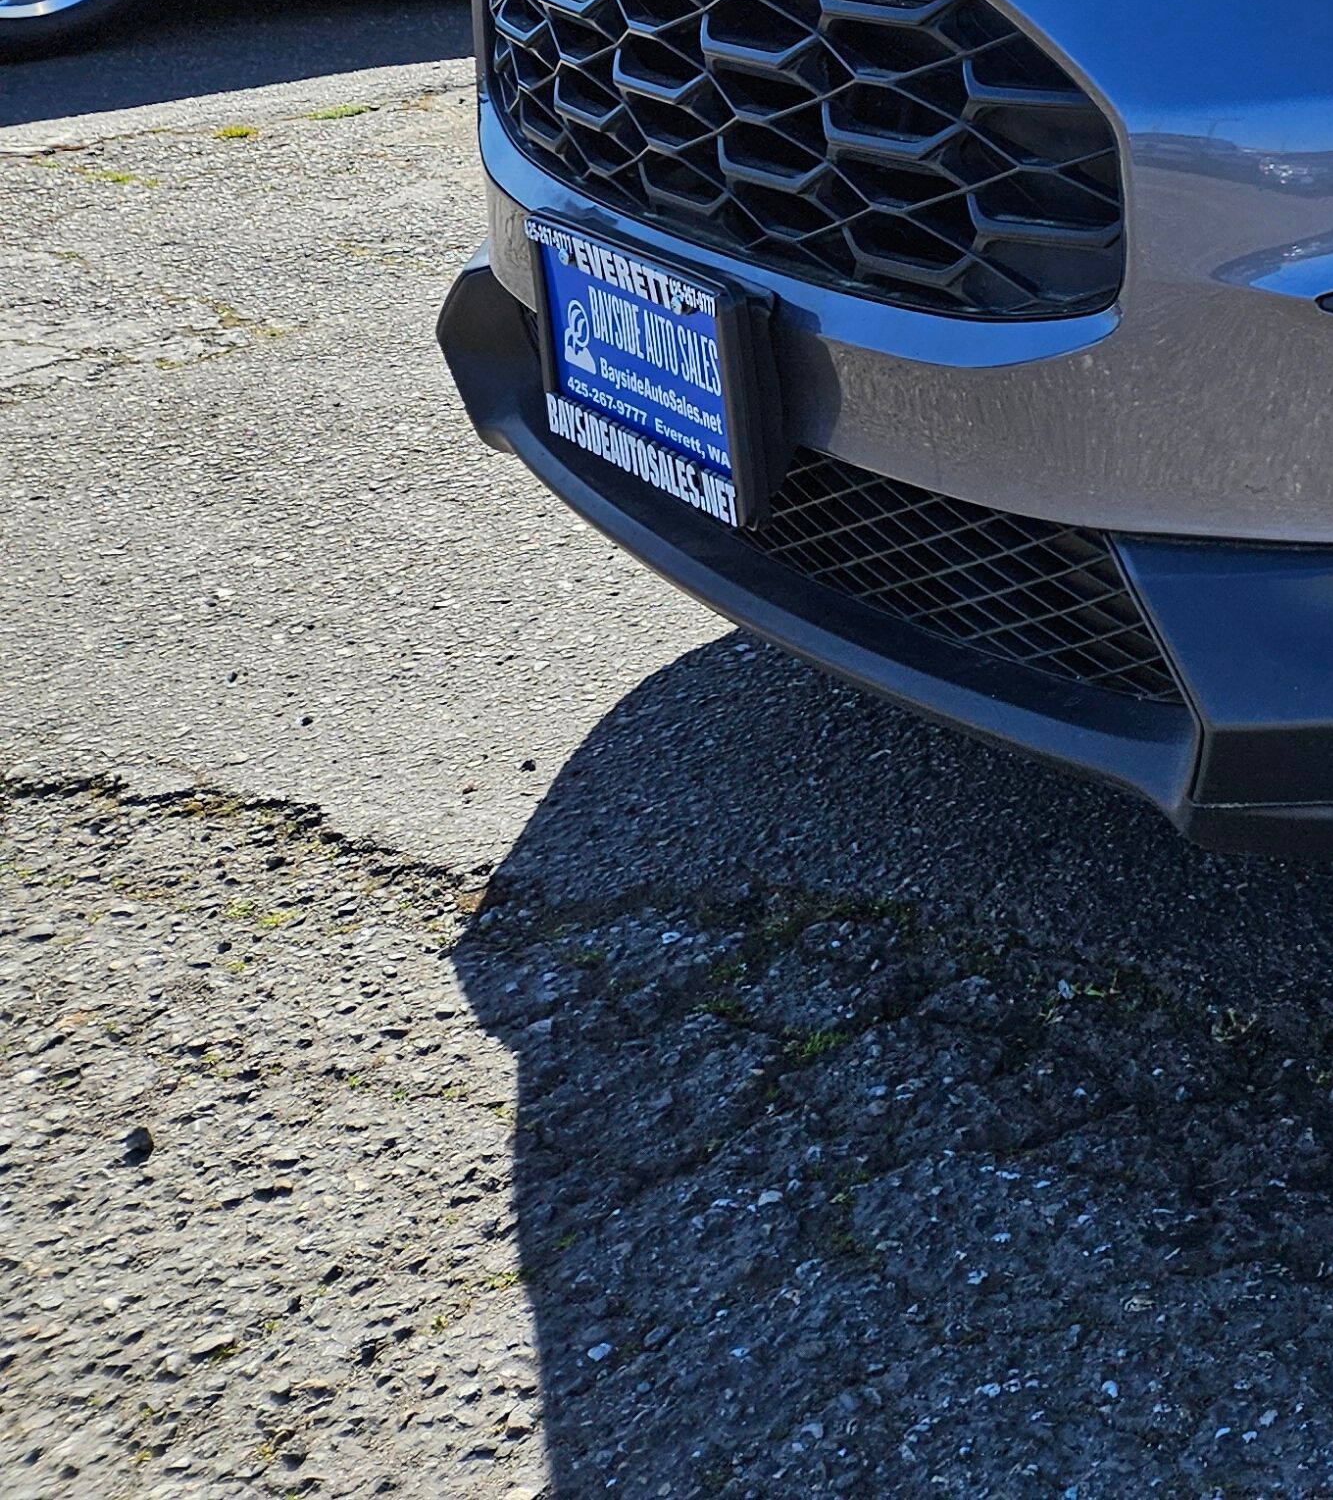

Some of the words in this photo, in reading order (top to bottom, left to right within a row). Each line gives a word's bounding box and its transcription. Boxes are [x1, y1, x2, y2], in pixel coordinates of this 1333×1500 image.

[571, 237, 671, 311] EVERETT
[588, 285, 645, 360] BAYSIDE
[643, 309, 679, 376] AUTO
[677, 324, 722, 397] SALES
[567, 376, 648, 426] 425-267-9777
[654, 417, 706, 460] Everett,
[706, 443, 732, 470] WA
[600, 357, 723, 436] BaysideAutoSales.net
[545, 391, 739, 528] BAYSIDEAUTOSALES.NET
